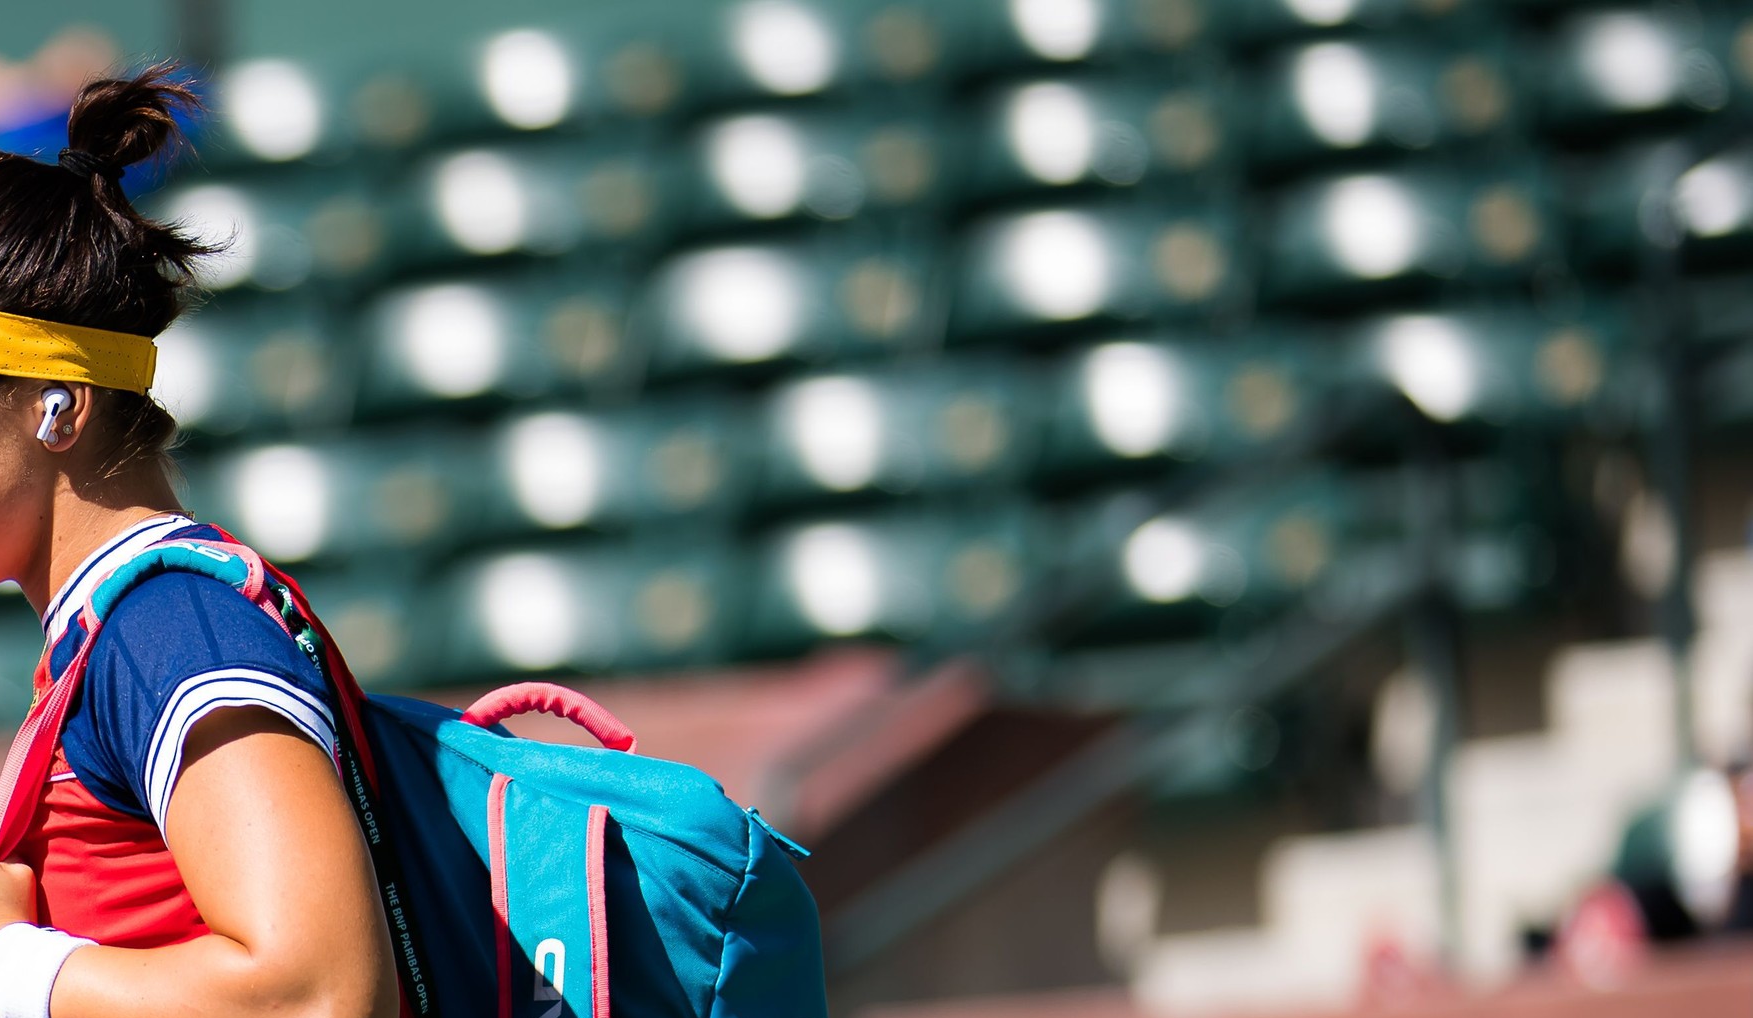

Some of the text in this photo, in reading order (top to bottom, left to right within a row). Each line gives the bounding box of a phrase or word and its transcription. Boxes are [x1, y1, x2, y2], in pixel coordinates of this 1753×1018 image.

[364, 811, 381, 845] OPEN
[386, 882, 429, 1015] THE BNP PARIBAS OPEN
